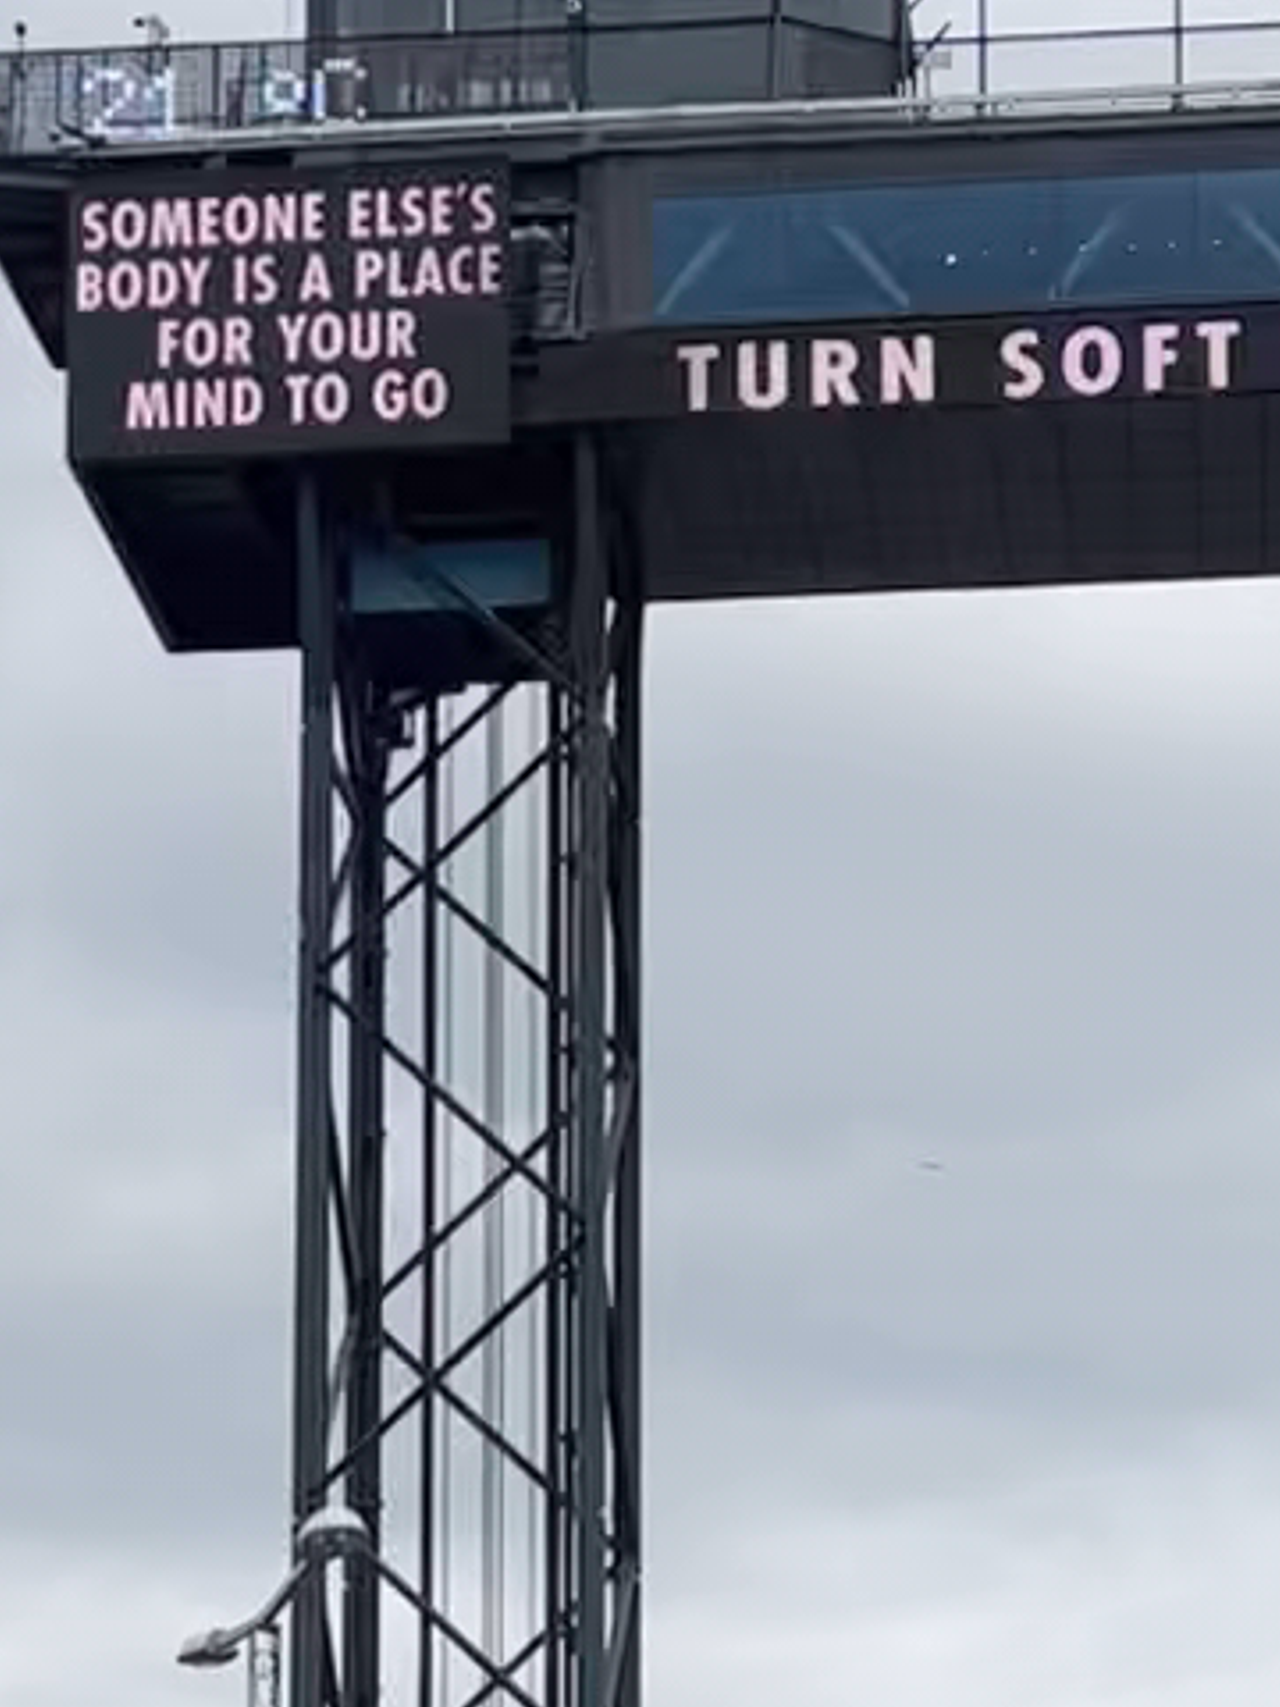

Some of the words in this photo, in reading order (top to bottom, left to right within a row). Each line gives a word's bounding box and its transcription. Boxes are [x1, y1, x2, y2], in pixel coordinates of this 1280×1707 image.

[82, 195, 325, 252] SOMEONE
[349, 183, 496, 239] ELSE'S
[76, 258, 210, 312] BODY
[234, 255, 278, 304] IS
[300, 253, 332, 302] A
[355, 244, 501, 298] PLACE
[158, 316, 252, 368] FOR
[277, 309, 416, 363] YOUR
[677, 335, 936, 411] TURN
[1000, 321, 1242, 398] SOFT
[126, 378, 263, 430] MIND
[285, 373, 349, 424] TO
[372, 368, 448, 421] GO
